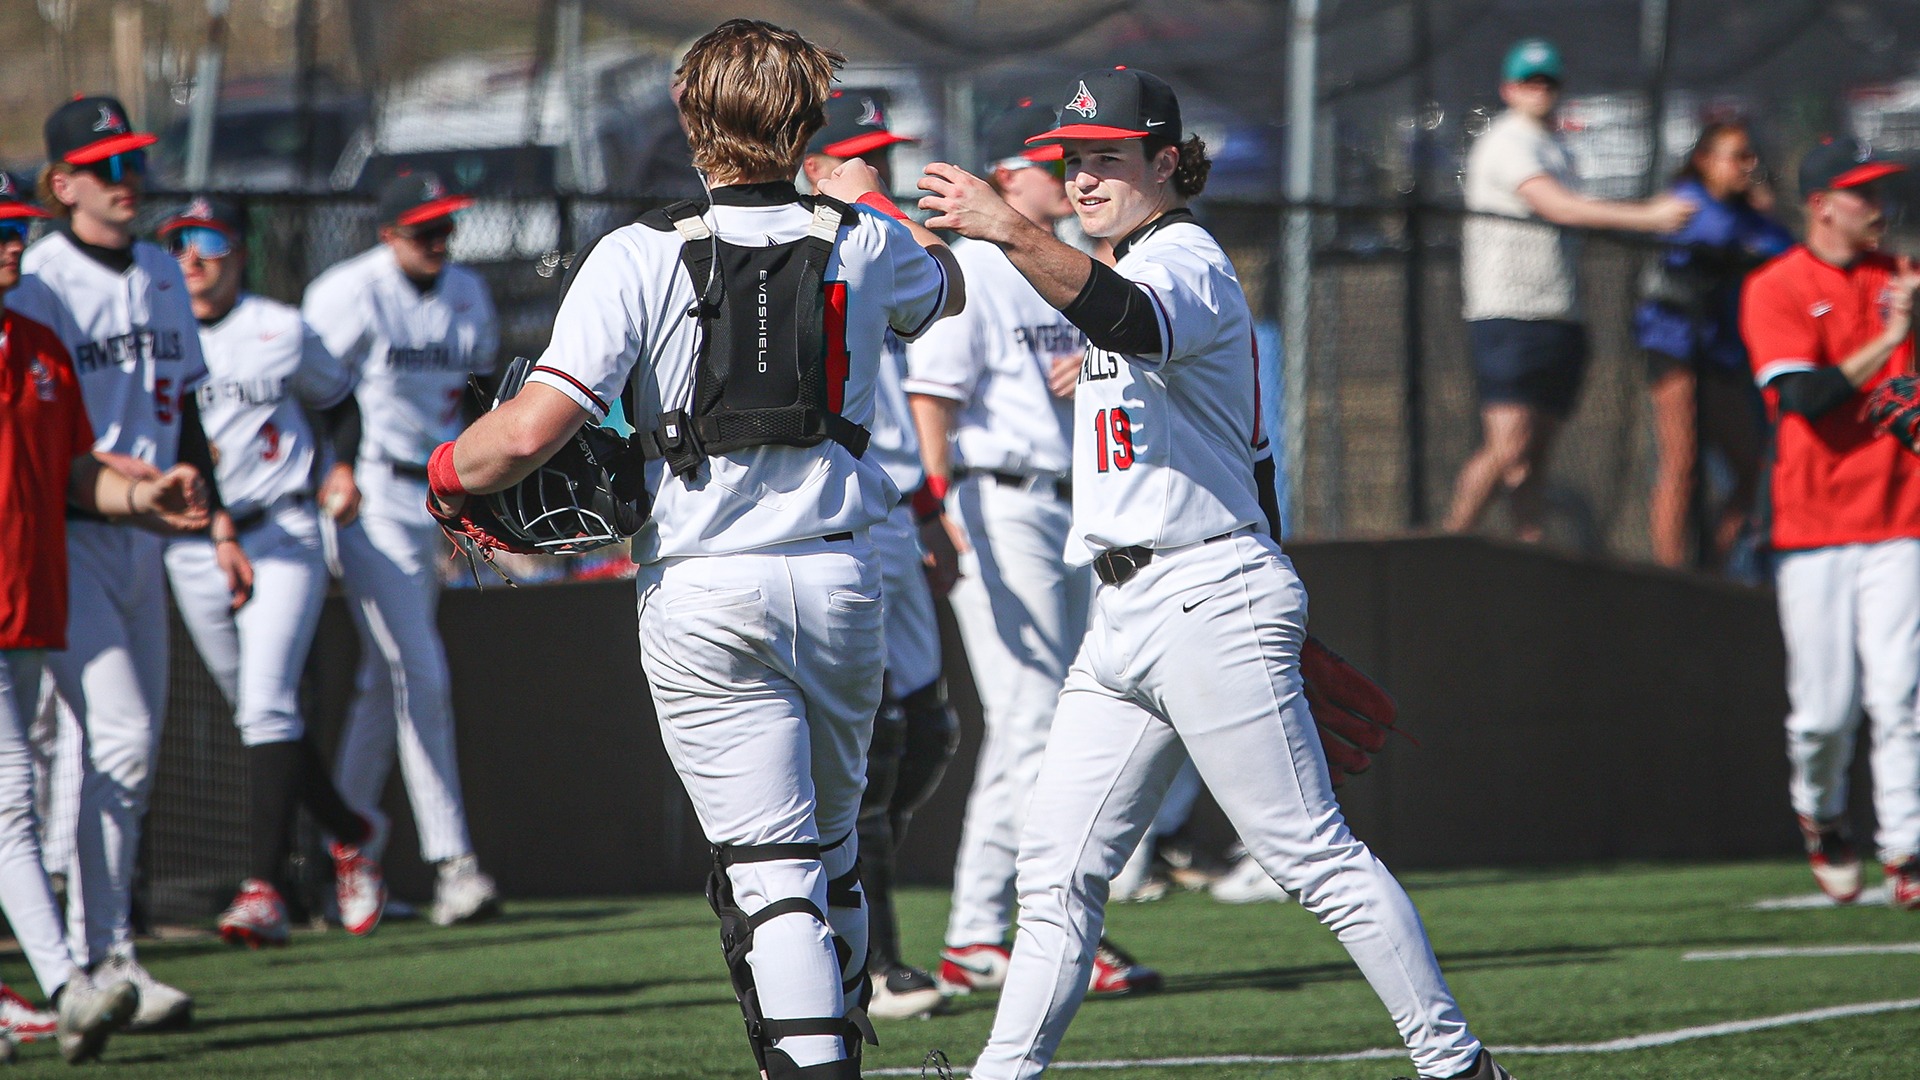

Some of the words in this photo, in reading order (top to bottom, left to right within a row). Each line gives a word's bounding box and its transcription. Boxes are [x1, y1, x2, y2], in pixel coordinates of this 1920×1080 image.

[757, 269, 769, 374] EVOSHIELD
[1078, 346, 1119, 385] ALLS
[1094, 407, 1135, 474] 19
